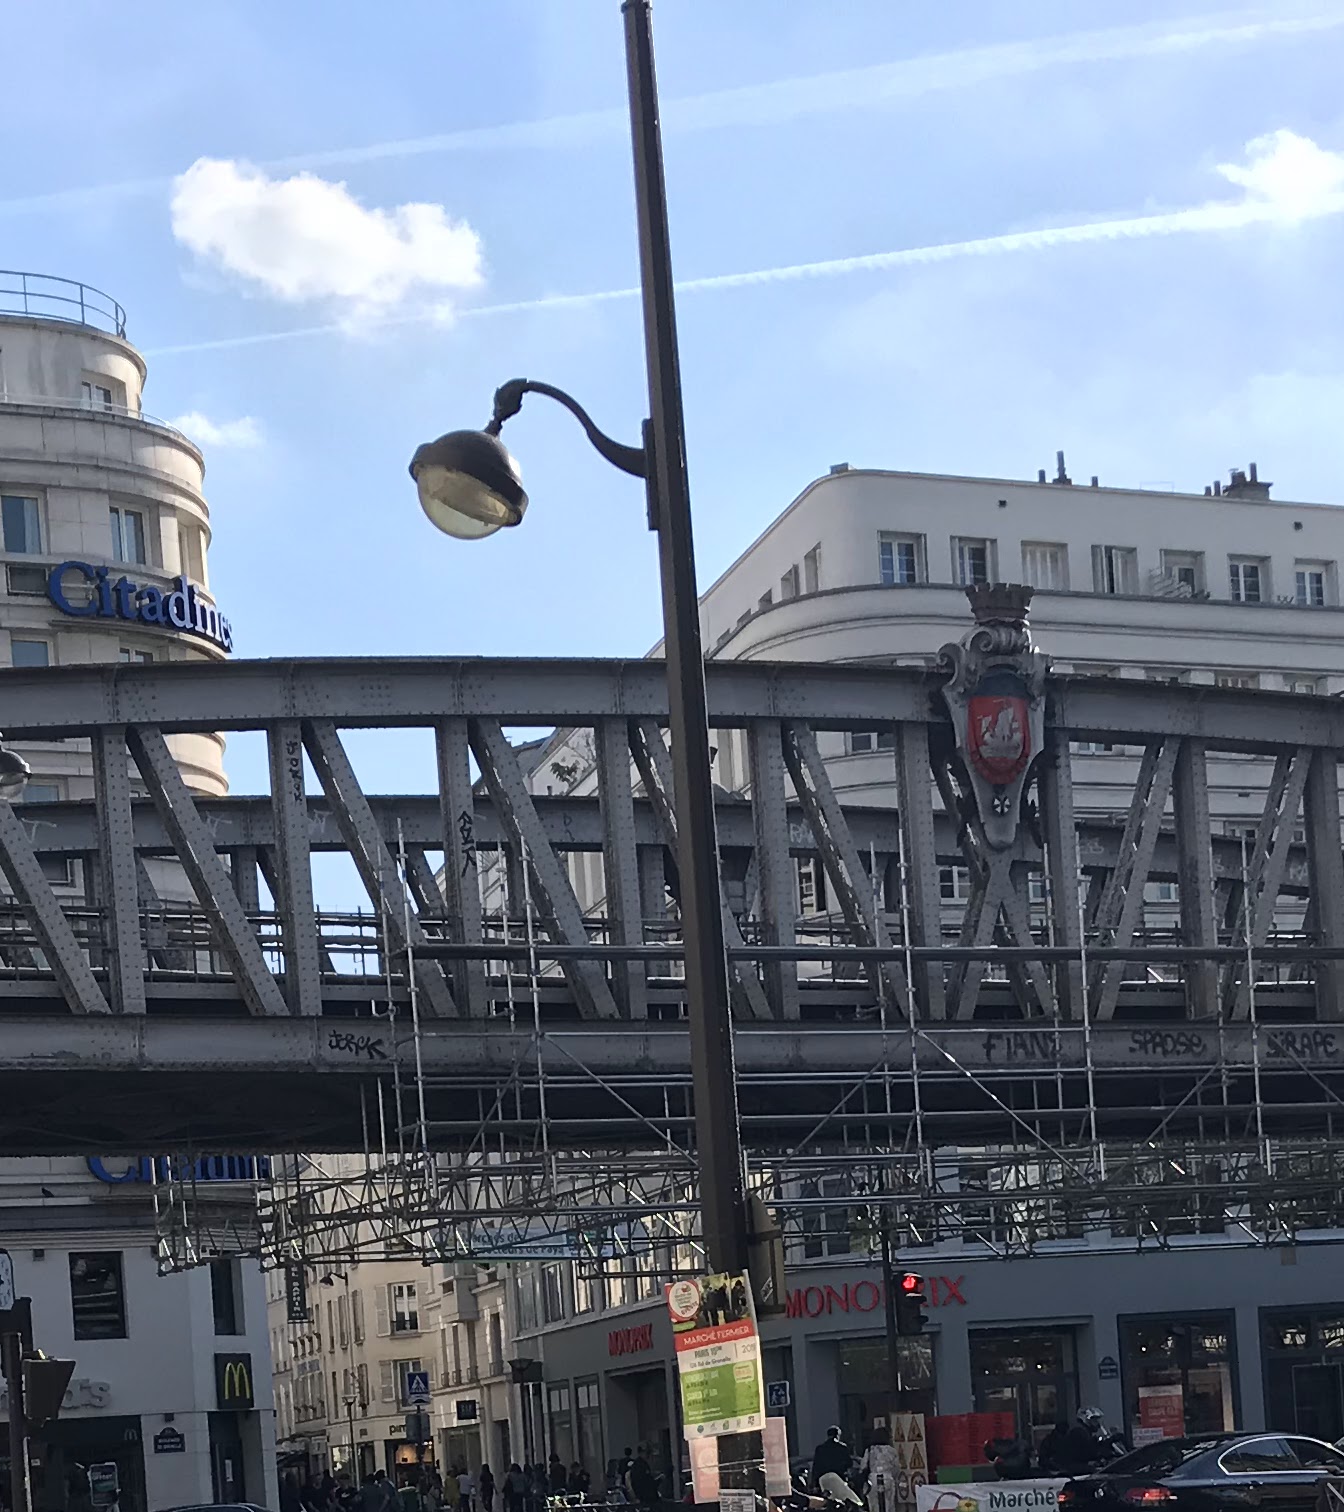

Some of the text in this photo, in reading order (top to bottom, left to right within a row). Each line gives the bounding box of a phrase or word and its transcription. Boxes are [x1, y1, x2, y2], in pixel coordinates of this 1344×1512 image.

[785, 1275, 967, 1319] MONOIX
[683, 1326, 750, 1345] MARCHÉ FERMIER
